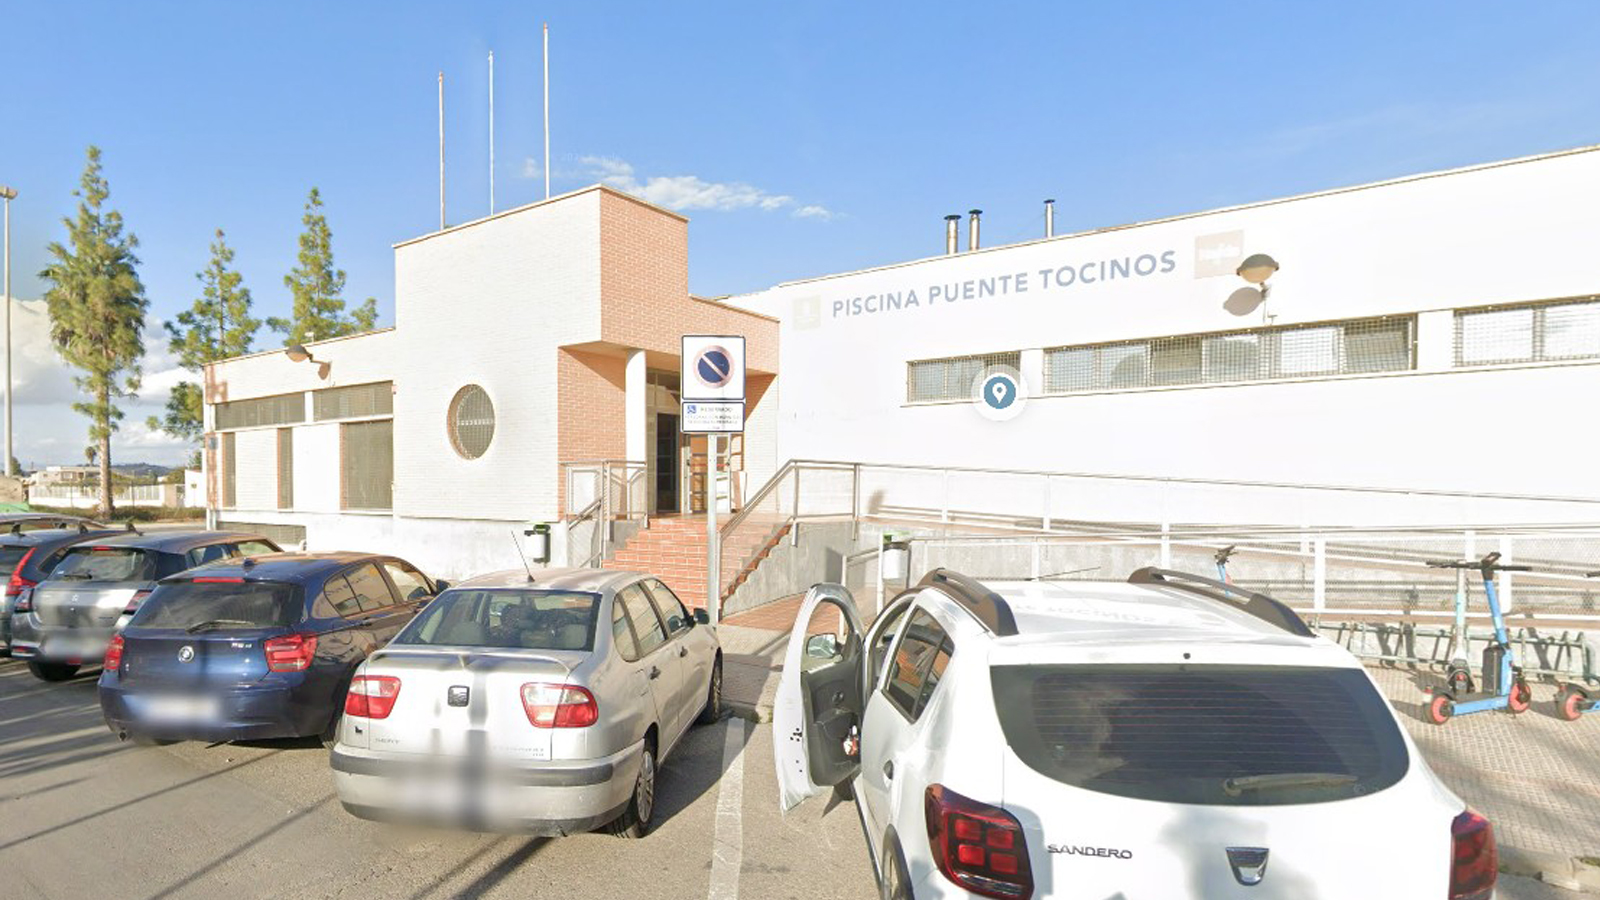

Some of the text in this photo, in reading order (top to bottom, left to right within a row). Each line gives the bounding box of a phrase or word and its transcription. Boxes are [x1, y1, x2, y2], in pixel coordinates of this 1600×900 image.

[832, 289, 920, 318] PISCINA
[928, 272, 1029, 305] PUENTE
[1039, 250, 1176, 289] TOCINOS
[1047, 843, 1133, 859] SANDERO
